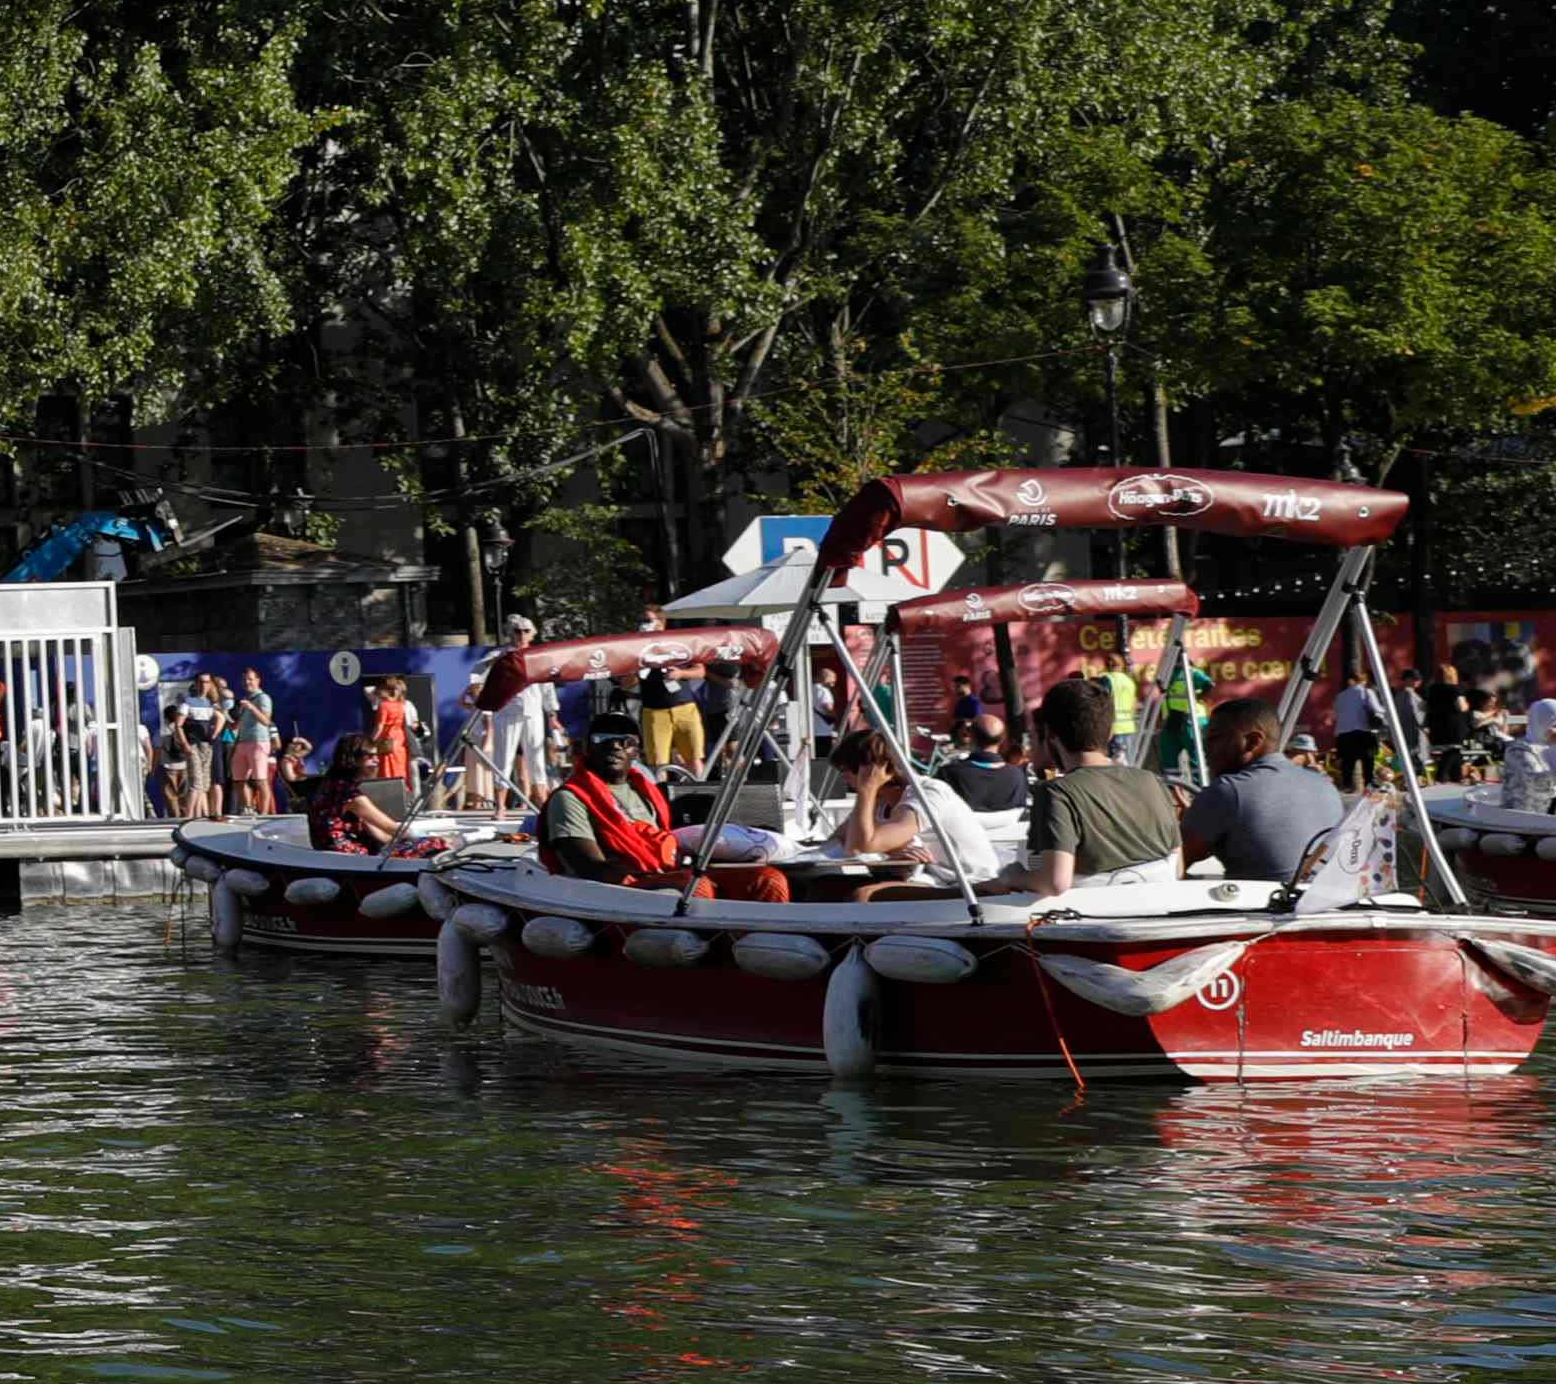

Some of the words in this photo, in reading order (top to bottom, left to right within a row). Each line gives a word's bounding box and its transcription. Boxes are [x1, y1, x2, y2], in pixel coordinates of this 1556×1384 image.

[1262, 489, 1321, 521] mk2
[1007, 514, 1056, 526] PARIS
[1079, 625, 1118, 650] Ce
[1210, 978, 1230, 999] 11
[1300, 1029, 1414, 1050] Saltimbanque
